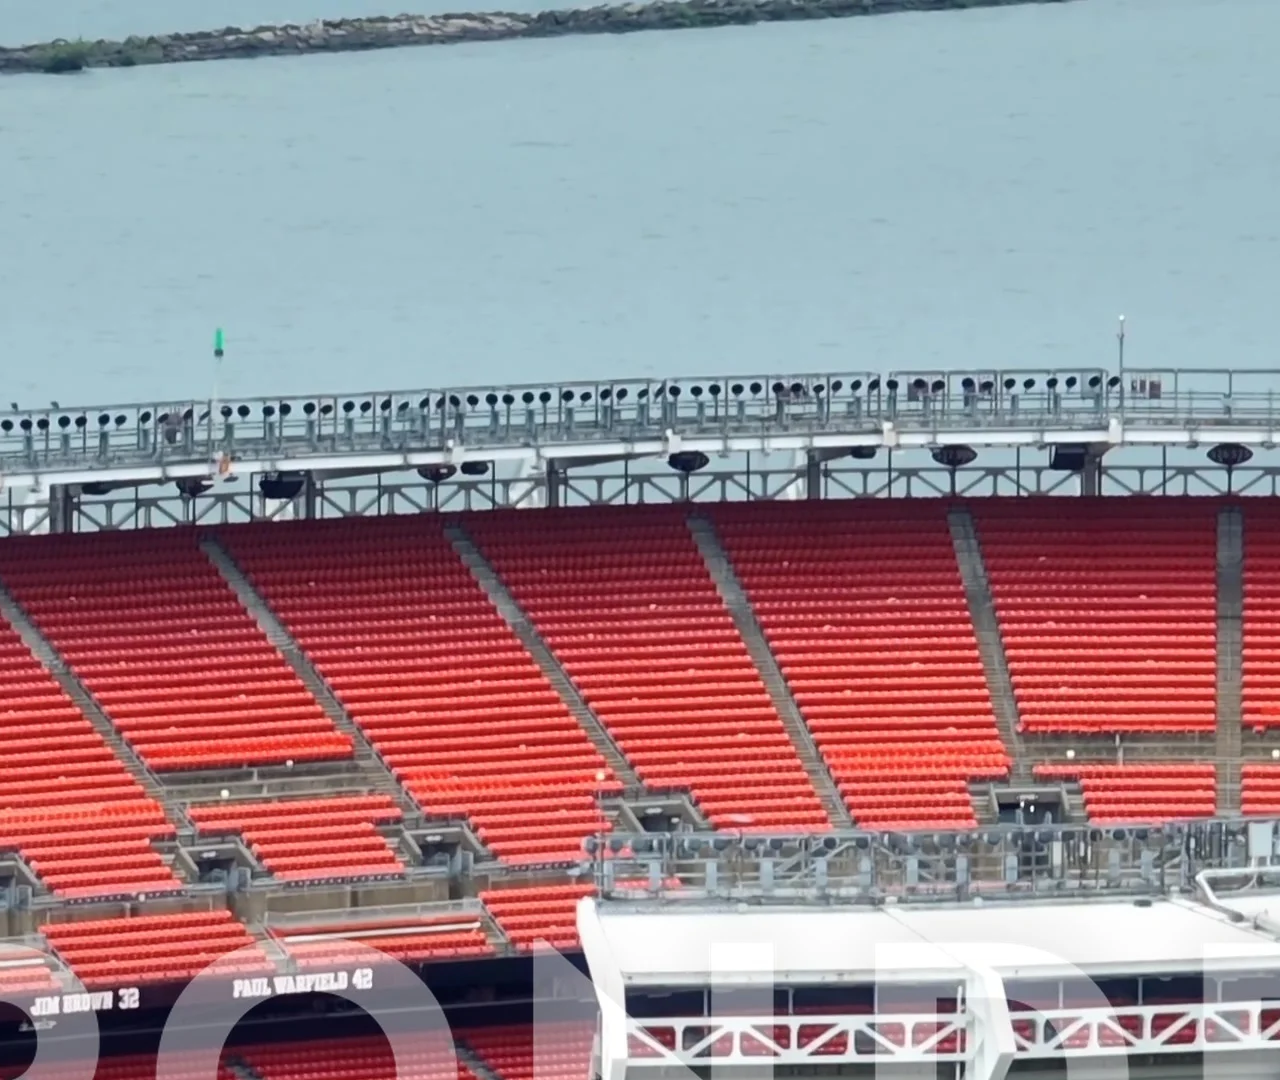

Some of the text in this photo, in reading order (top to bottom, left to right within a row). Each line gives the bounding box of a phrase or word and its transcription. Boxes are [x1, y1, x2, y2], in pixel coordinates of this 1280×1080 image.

[233, 968, 373, 998] PAUL WARFIELD 42
[30, 987, 140, 1017] JIM BROWN 32
